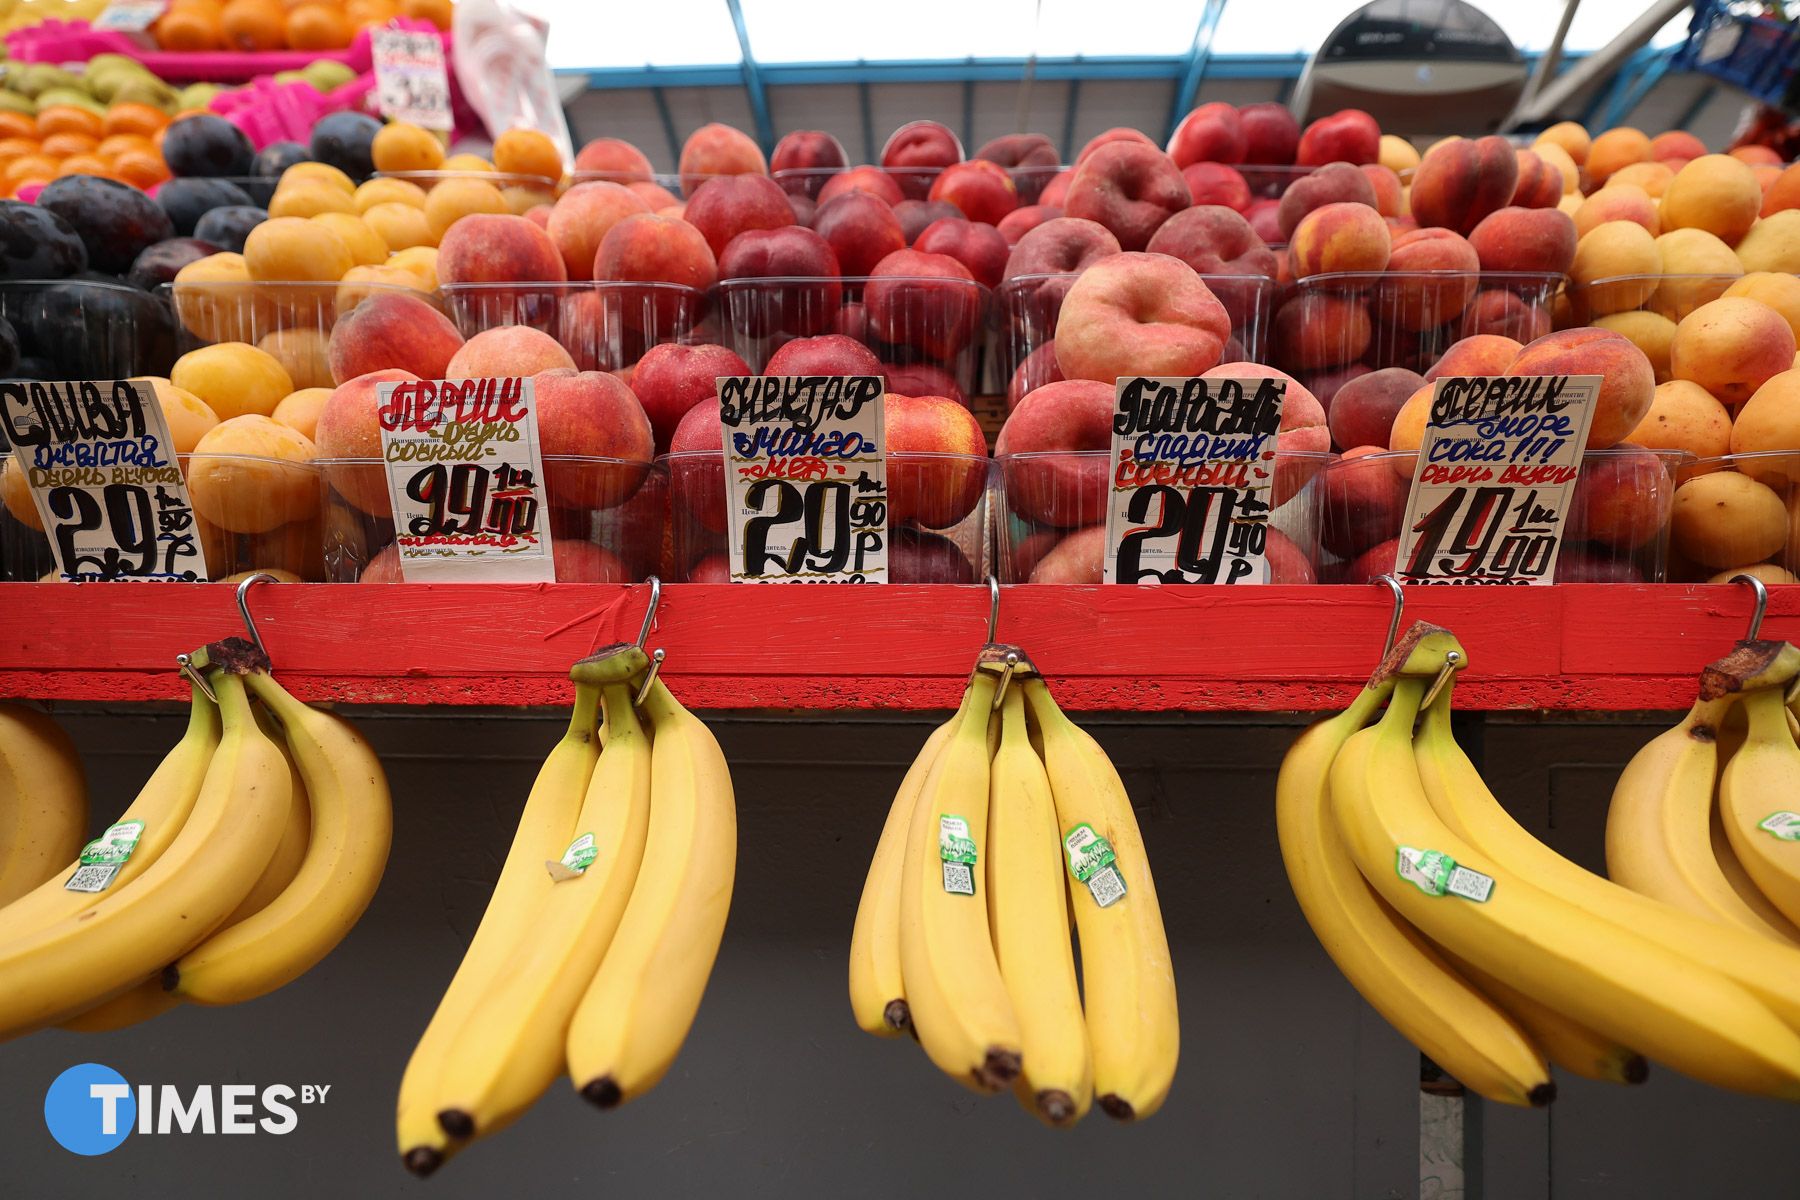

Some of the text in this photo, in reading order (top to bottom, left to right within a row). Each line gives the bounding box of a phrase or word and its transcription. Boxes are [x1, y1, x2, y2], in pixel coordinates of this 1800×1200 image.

[48, 483, 158, 577] 29
[744, 479, 850, 576] 29
[1115, 485, 1239, 584] 29
